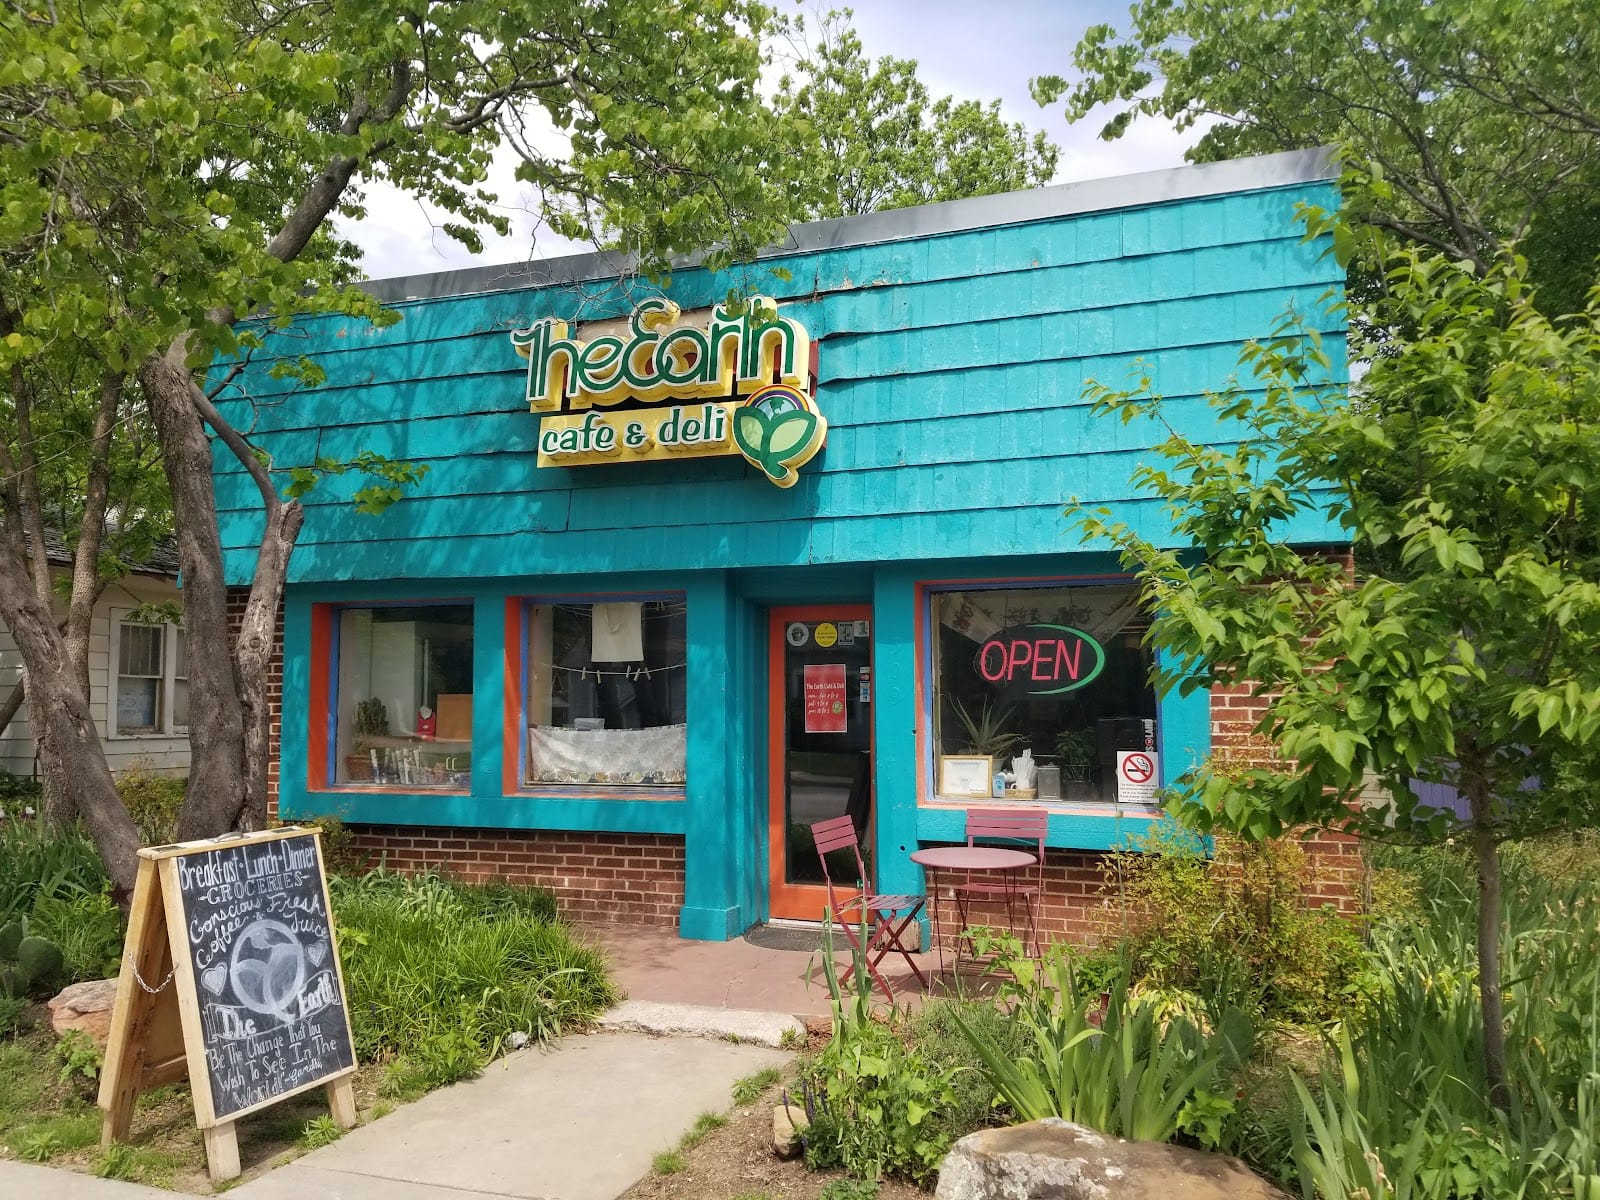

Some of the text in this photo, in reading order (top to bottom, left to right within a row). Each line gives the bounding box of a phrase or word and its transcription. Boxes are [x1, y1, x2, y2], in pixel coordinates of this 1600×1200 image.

[542, 402, 726, 454] cafe & deli
[980, 639, 1082, 682] OPEN
[267, 892, 326, 917] Fresh
[196, 916, 249, 969] Coffee
[283, 911, 329, 938] Juice
[215, 972, 334, 1038] The Earth
[246, 1036, 284, 1058] Change
[262, 1055, 287, 1076] See
[289, 1042, 312, 1065] In
[311, 1035, 337, 1055] The
